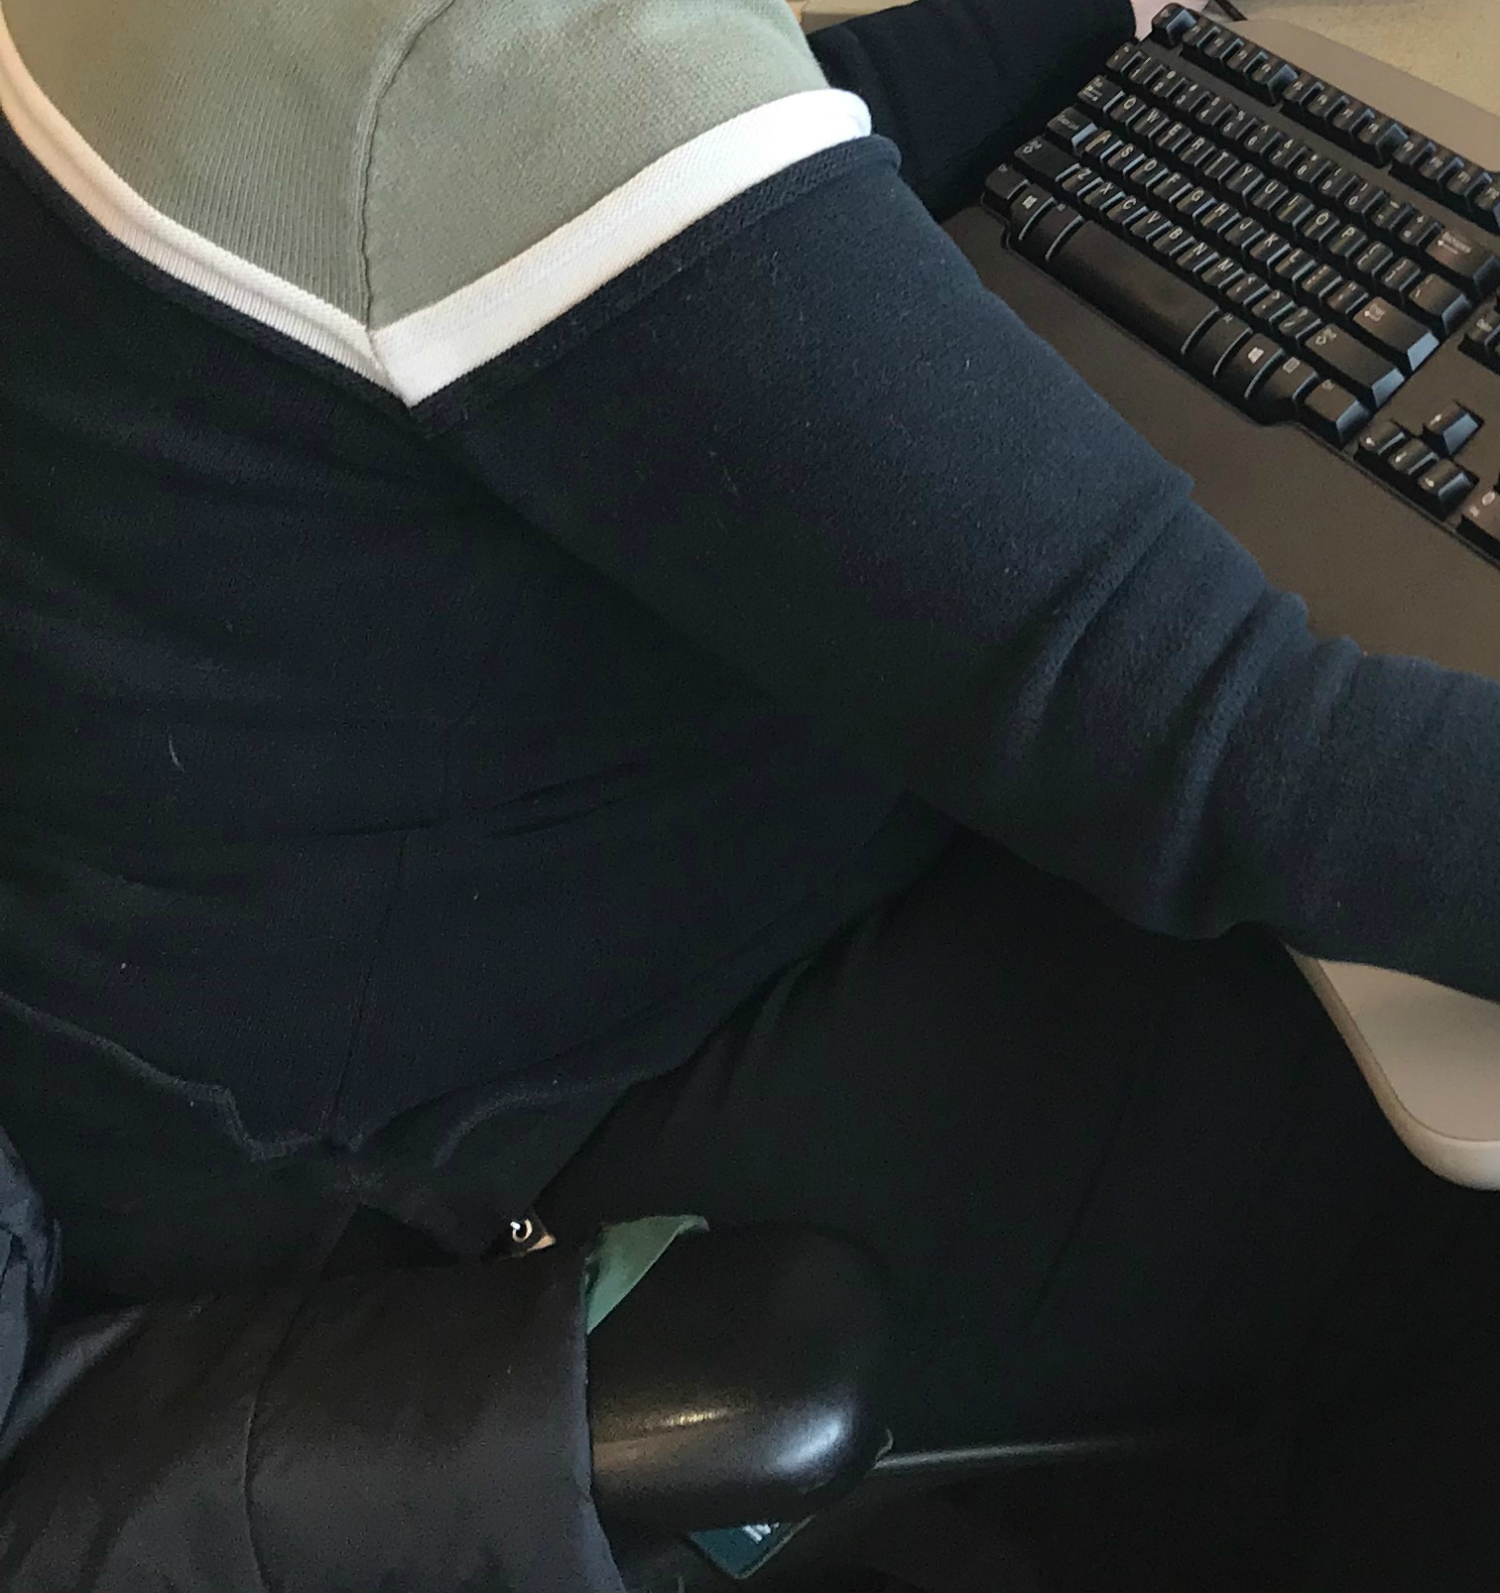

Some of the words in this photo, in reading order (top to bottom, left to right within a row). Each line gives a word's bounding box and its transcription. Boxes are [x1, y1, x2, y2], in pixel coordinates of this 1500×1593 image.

[1077, 168, 1092, 181] Z
[1099, 182, 1114, 195] X
[1123, 197, 1137, 210] C
[1147, 213, 1162, 224] V
[1169, 227, 1184, 240] B
[1193, 242, 1209, 256] N
[1121, 145, 1134, 158] S
[1167, 173, 1181, 184] F
[1191, 189, 1205, 202] G
[1215, 203, 1230, 215] H
[1239, 220, 1253, 231] J
[1264, 233, 1279, 247] K
[1289, 249, 1303, 263] L
[1123, 96, 1137, 110] Q
[1146, 109, 1160, 123] W
[1168, 123, 1183, 137] E
[1191, 137, 1206, 151] R
[1240, 165, 1253, 178] Y
[1264, 181, 1279, 195] U
[1316, 212, 1329, 226] O
[1341, 227, 1355, 239] P
